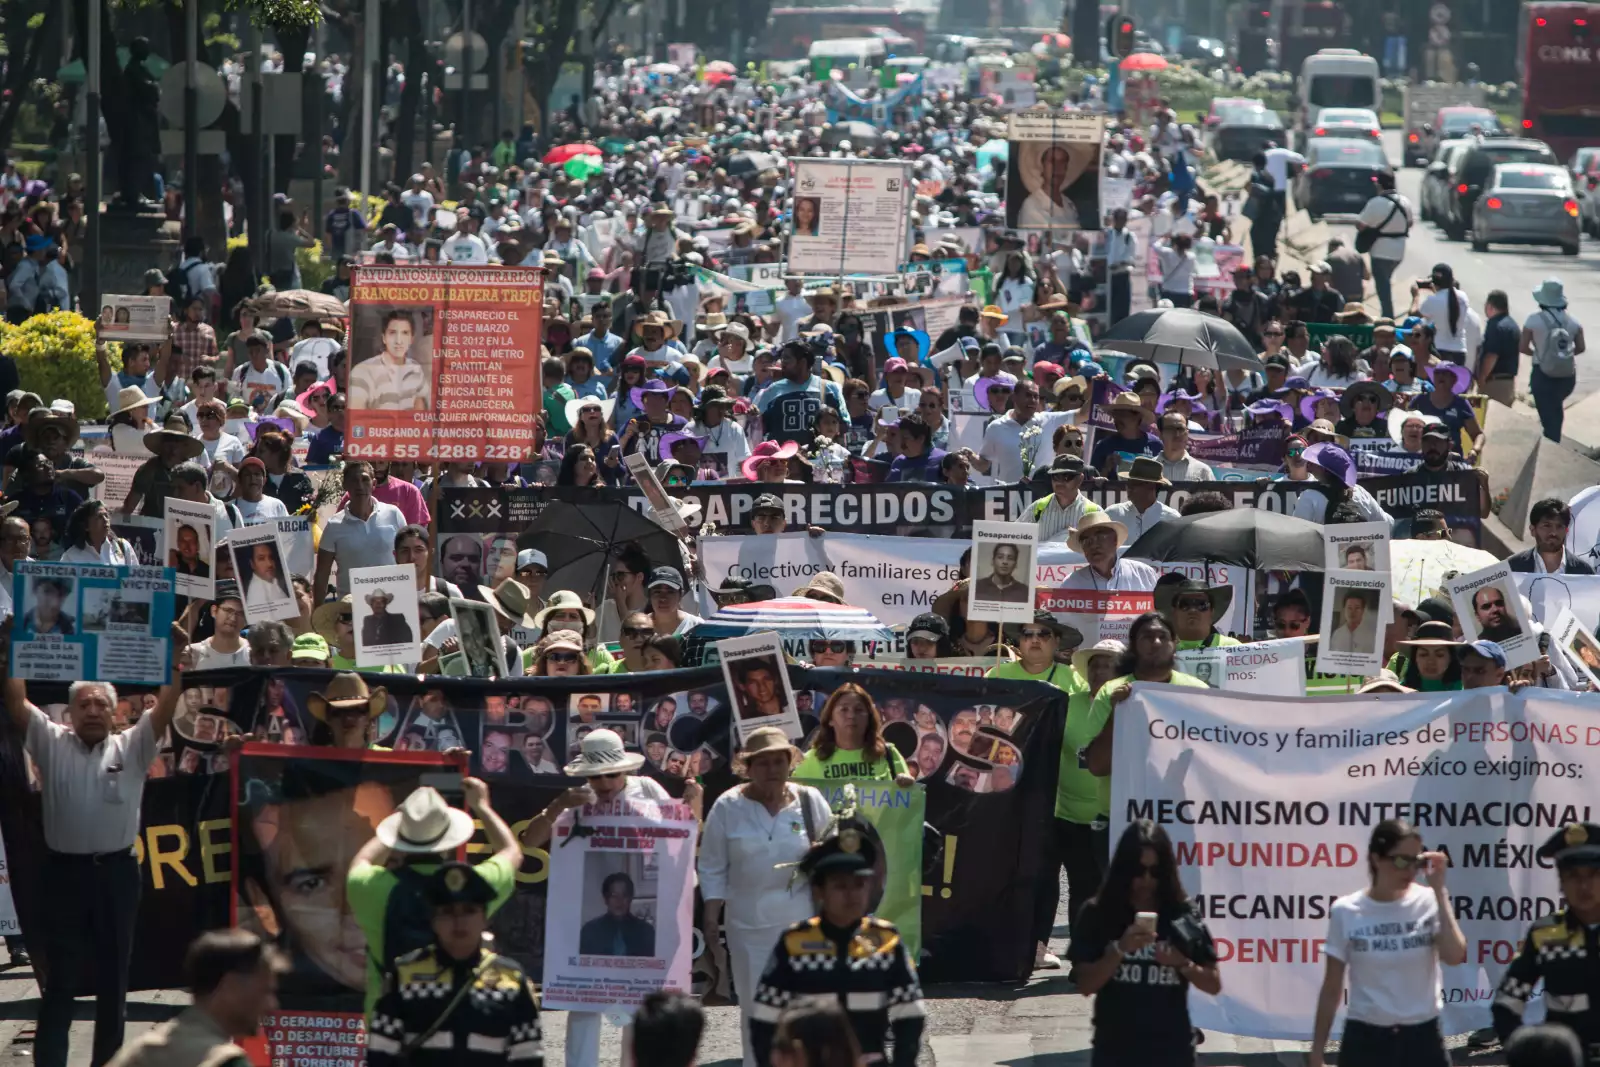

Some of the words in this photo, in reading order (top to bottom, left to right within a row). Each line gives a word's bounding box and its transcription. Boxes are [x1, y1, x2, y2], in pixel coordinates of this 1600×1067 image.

[430, 271, 439, 284] A
[441, 270, 541, 286] ENCONTRARLO!
[352, 285, 428, 301] FRANCISCO
[432, 286, 499, 302] ALBAVERA
[501, 288, 541, 306] TREJO
[438, 310, 506, 321] DESAPARECIO
[507, 311, 519, 321] EL
[447, 323, 460, 333] 26
[461, 323, 474, 333] DE
[475, 323, 510, 333] MARZO
[442, 335, 460, 345] DEL
[462, 335, 485, 346] 2012
[486, 336, 499, 346] EN
[501, 336, 514, 346] LA
[433, 349, 461, 359] LINEA
[462, 349, 468, 359] 1
[470, 349, 489, 359] DEL
[490, 349, 525, 359] METRO
[450, 361, 502, 371] PANTITLAN
[439, 374, 498, 384] ESTUDIANTE
[500, 374, 513, 384] DE
[438, 387, 476, 397] UPIICSA
[477, 387, 496, 397] DEL
[497, 387, 514, 397] IPN
[436, 400, 448, 410] SE
[449, 400, 515, 410] AGRADECERA
[413, 412, 468, 424] CUALQUIER
[469, 413, 535, 424] INFORMACION
[782, 397, 821, 431] 88
[368, 427, 421, 438] BUSCANDO
[422, 428, 430, 438] A
[432, 428, 483, 439] FRANCISCO
[485, 429, 533, 440] ALBAVERA
[347, 444, 388, 458] 044
[394, 444, 420, 458] 55
[427, 445, 478, 459] 4288
[484, 445, 533, 460] 2281
[1358, 452, 1410, 471] ESTAMOS
[1376, 483, 1466, 508] FUNDENL
[168, 506, 212, 520] Desaparecido
[278, 520, 309, 533] ARCIA
[231, 533, 276, 547] Desaparecido
[977, 530, 1034, 542] Desaparecido
[1329, 533, 1385, 543] Desaparecido
[17, 564, 77, 577] JUSTICIA
[81, 567, 116, 579] PARA
[129, 569, 163, 579] JOSE
[728, 562, 820, 581] Colectivos
[841, 561, 932, 580] familiares
[936, 564, 960, 581] de
[121, 580, 170, 591] VICTOR
[353, 573, 411, 585] Desaparecido
[1329, 577, 1386, 589] Desaparecido
[1453, 569, 1508, 595] Desaparecido
[881, 592, 904, 606] en
[910, 589, 939, 606] Mé
[1040, 597, 1093, 612] ¿DONDE
[1097, 598, 1133, 611] ESTA
[1136, 599, 1152, 611] MI
[1099, 633, 1128, 641] MOREN
[723, 643, 776, 659] Desaparecido
[784, 638, 806, 657] NA
[1225, 652, 1279, 667] RECIDAS
[1227, 669, 1257, 681] mos:
[1147, 718, 1269, 748] Colectivos
[1276, 728, 1290, 752] y
[1295, 726, 1410, 749] familiares
[1416, 723, 1446, 745] de
[1453, 721, 1577, 744] PERSONAS
[823, 761, 876, 779] ¿DONDE
[1347, 759, 1376, 779] en
[1384, 756, 1467, 778] México
[1474, 756, 1584, 782] exigimos:
[1126, 798, 1330, 827] MECANISMO
[1176, 841, 1359, 869] MPUNIDAD
[1462, 838, 1554, 870] MÉXIC
[1372, 935, 1398, 952] MÁS
[1214, 938, 1328, 964] DENTIF
[279, 1015, 343, 1029] GERARDO
[347, 1019, 366, 1030] GA
[288, 1031, 369, 1045] DESAPARECI
[276, 1045, 293, 1056] DE
[296, 1045, 359, 1057] OCTUBRE
